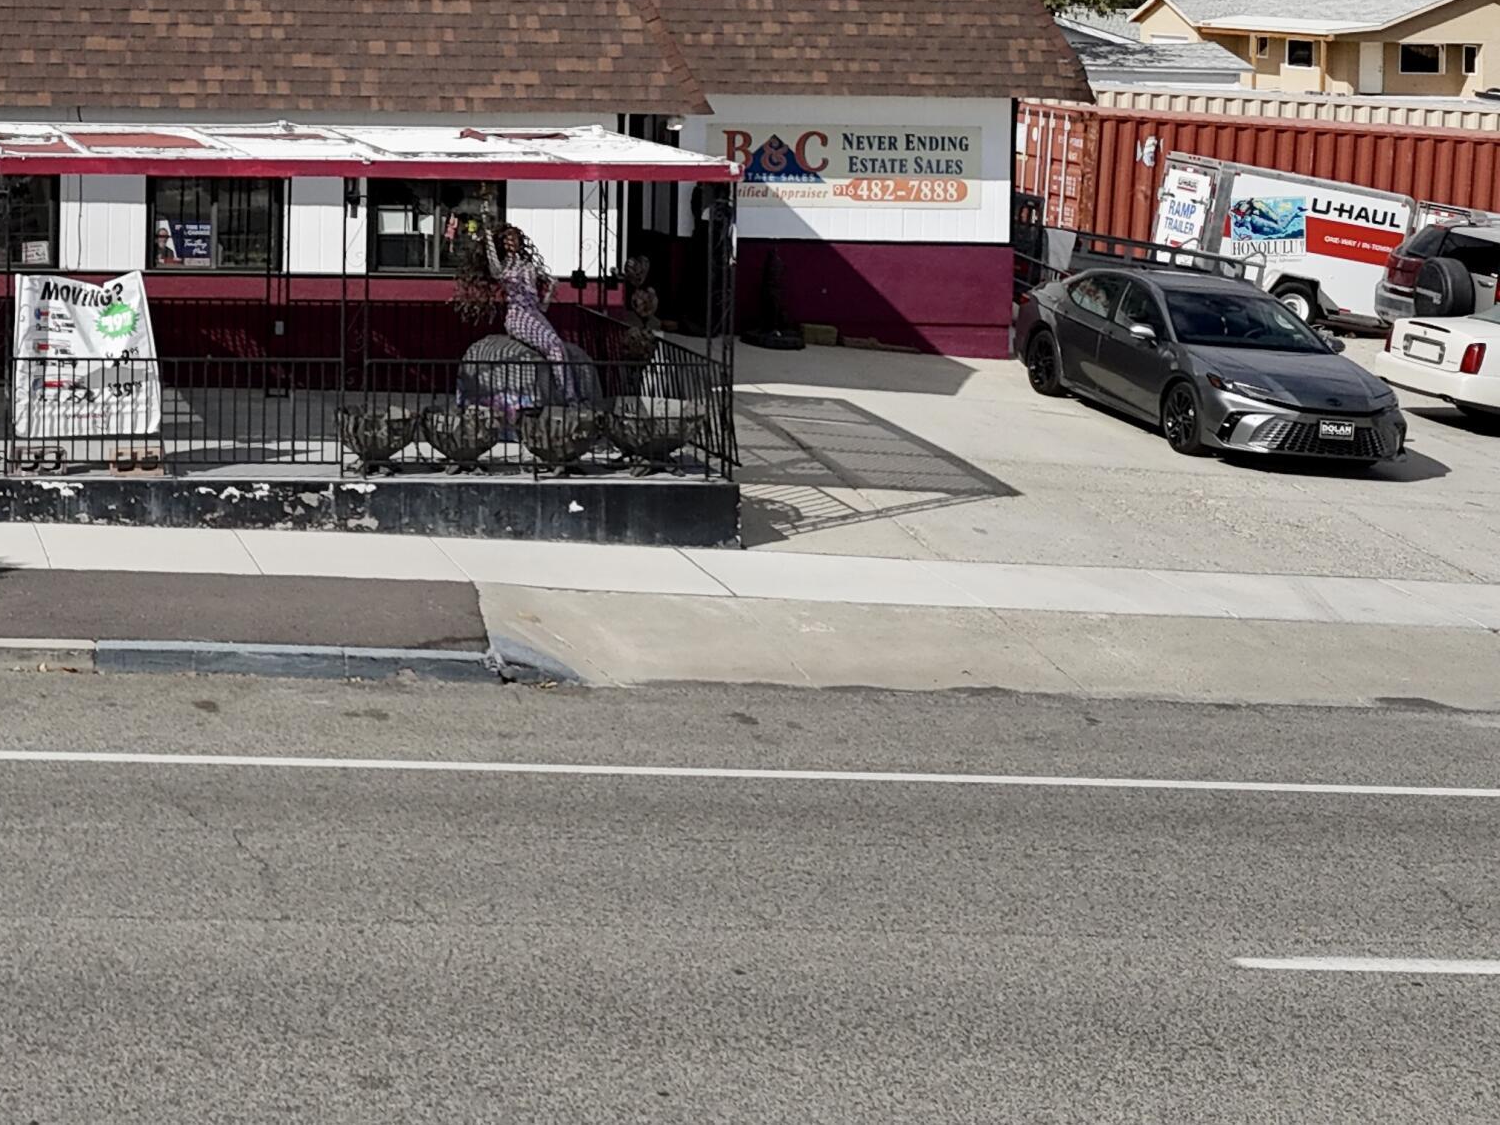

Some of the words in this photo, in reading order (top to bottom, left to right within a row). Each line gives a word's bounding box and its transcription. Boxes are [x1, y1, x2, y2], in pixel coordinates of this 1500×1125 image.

[842, 132, 898, 152] NEVER
[904, 134, 970, 152] ENDING
[848, 155, 908, 175] ESTATE
[913, 155, 964, 175] SALES
[745, 172, 777, 183] TATE
[780, 172, 816, 183] SALES
[738, 185, 769, 200] tified
[834, 185, 856, 197] 916
[857, 180, 960, 202] 482-7888
[1168, 199, 1197, 219] RAMP
[1311, 198, 1401, 228] U-HAUL
[1164, 216, 1195, 235] TRAILER
[40, 281, 124, 308] MOVING?
